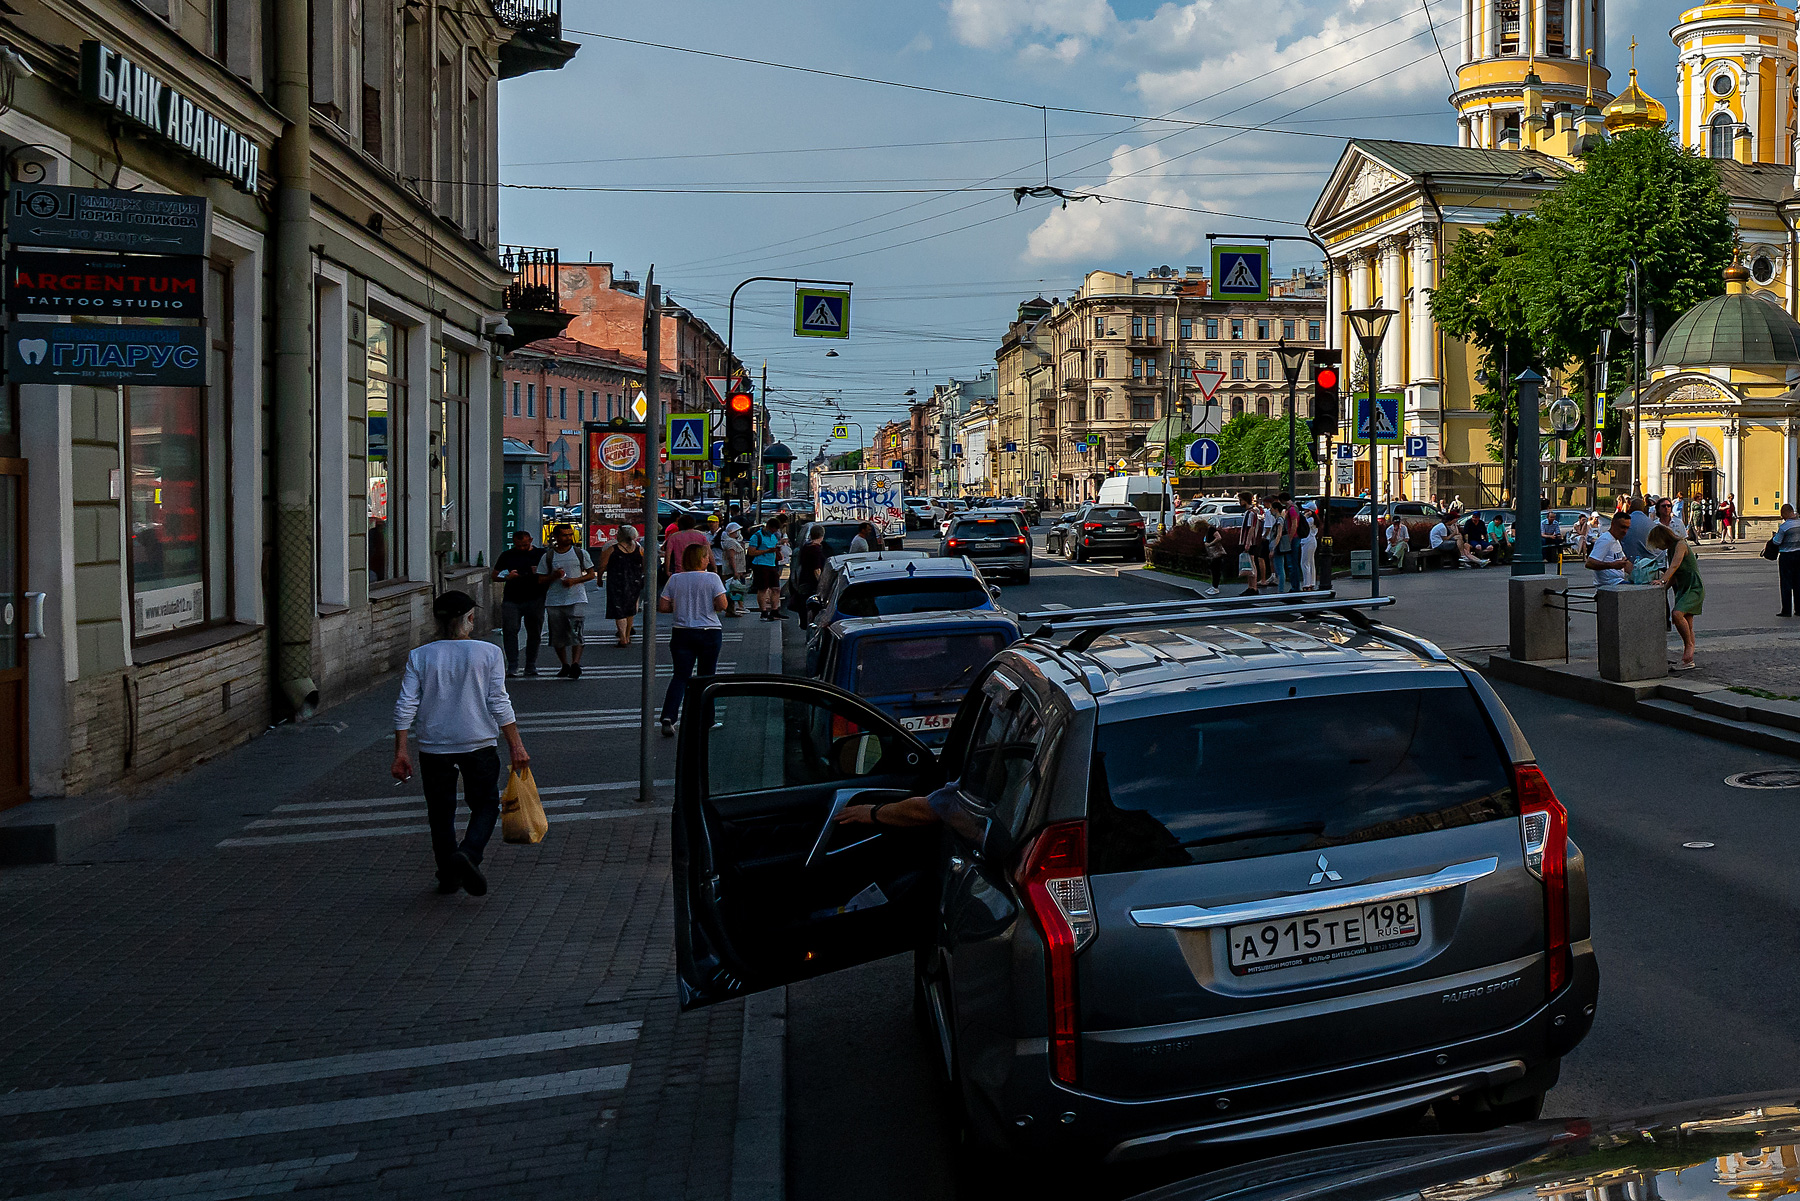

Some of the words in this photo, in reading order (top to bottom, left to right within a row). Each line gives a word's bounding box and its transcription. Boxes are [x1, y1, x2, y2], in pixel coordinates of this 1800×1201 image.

[99, 45, 161, 133] БАНК
[167, 90, 259, 195] АВАНГАРД
[80, 194, 142, 211] ИМИДЖ
[144, 199, 200, 215] СТУДИЯ
[80, 210, 122, 223] ЮРИЯ
[127, 213, 198, 228] ГОЛИКОВА
[68, 229, 90, 239] во
[94, 230, 152, 245] дворе
[14, 272, 197, 293] ARGENTUM
[27, 296, 105, 307] TATTOO
[112, 298, 183, 309] STUDIO
[52, 343, 199, 369] ГЛАРУС
[98, 371, 132, 379] дворе
[605, 442, 635, 454] BURGER
[605, 448, 635, 462] KING
[506, 486, 515, 550] ТУАЛЕТ
[1241, 917, 1361, 960] А915ТЕ
[1366, 902, 1410, 930] 198
[1377, 927, 1400, 938] RUS
[1247, 963, 1280, 973] MITSUBISHI
[1280, 958, 1303, 968] MOTORS
[1442, 987, 1484, 1004] PAJERO
[1486, 977, 1521, 994] SPORT
